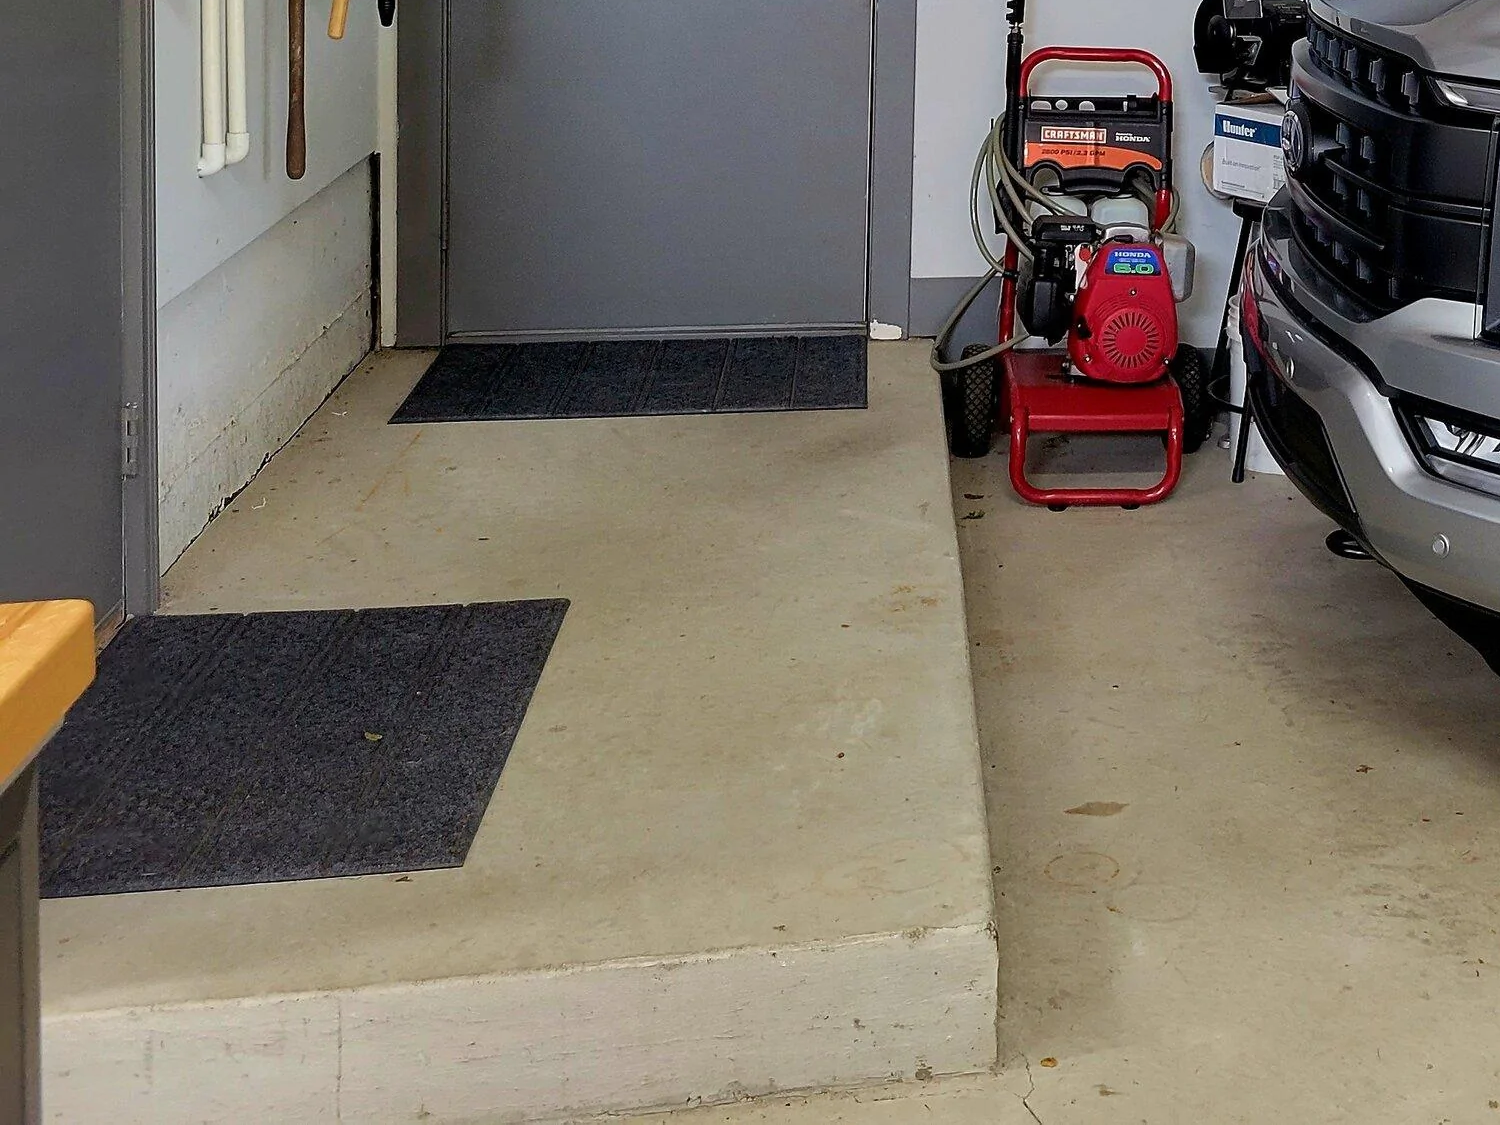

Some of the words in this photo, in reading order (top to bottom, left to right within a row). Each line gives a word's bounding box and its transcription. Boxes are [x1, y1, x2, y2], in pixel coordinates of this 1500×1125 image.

[1043, 129, 1105, 142] CRAFTSMAN
[1222, 120, 1256, 138] Hunter
[1115, 135, 1151, 143] HONDA
